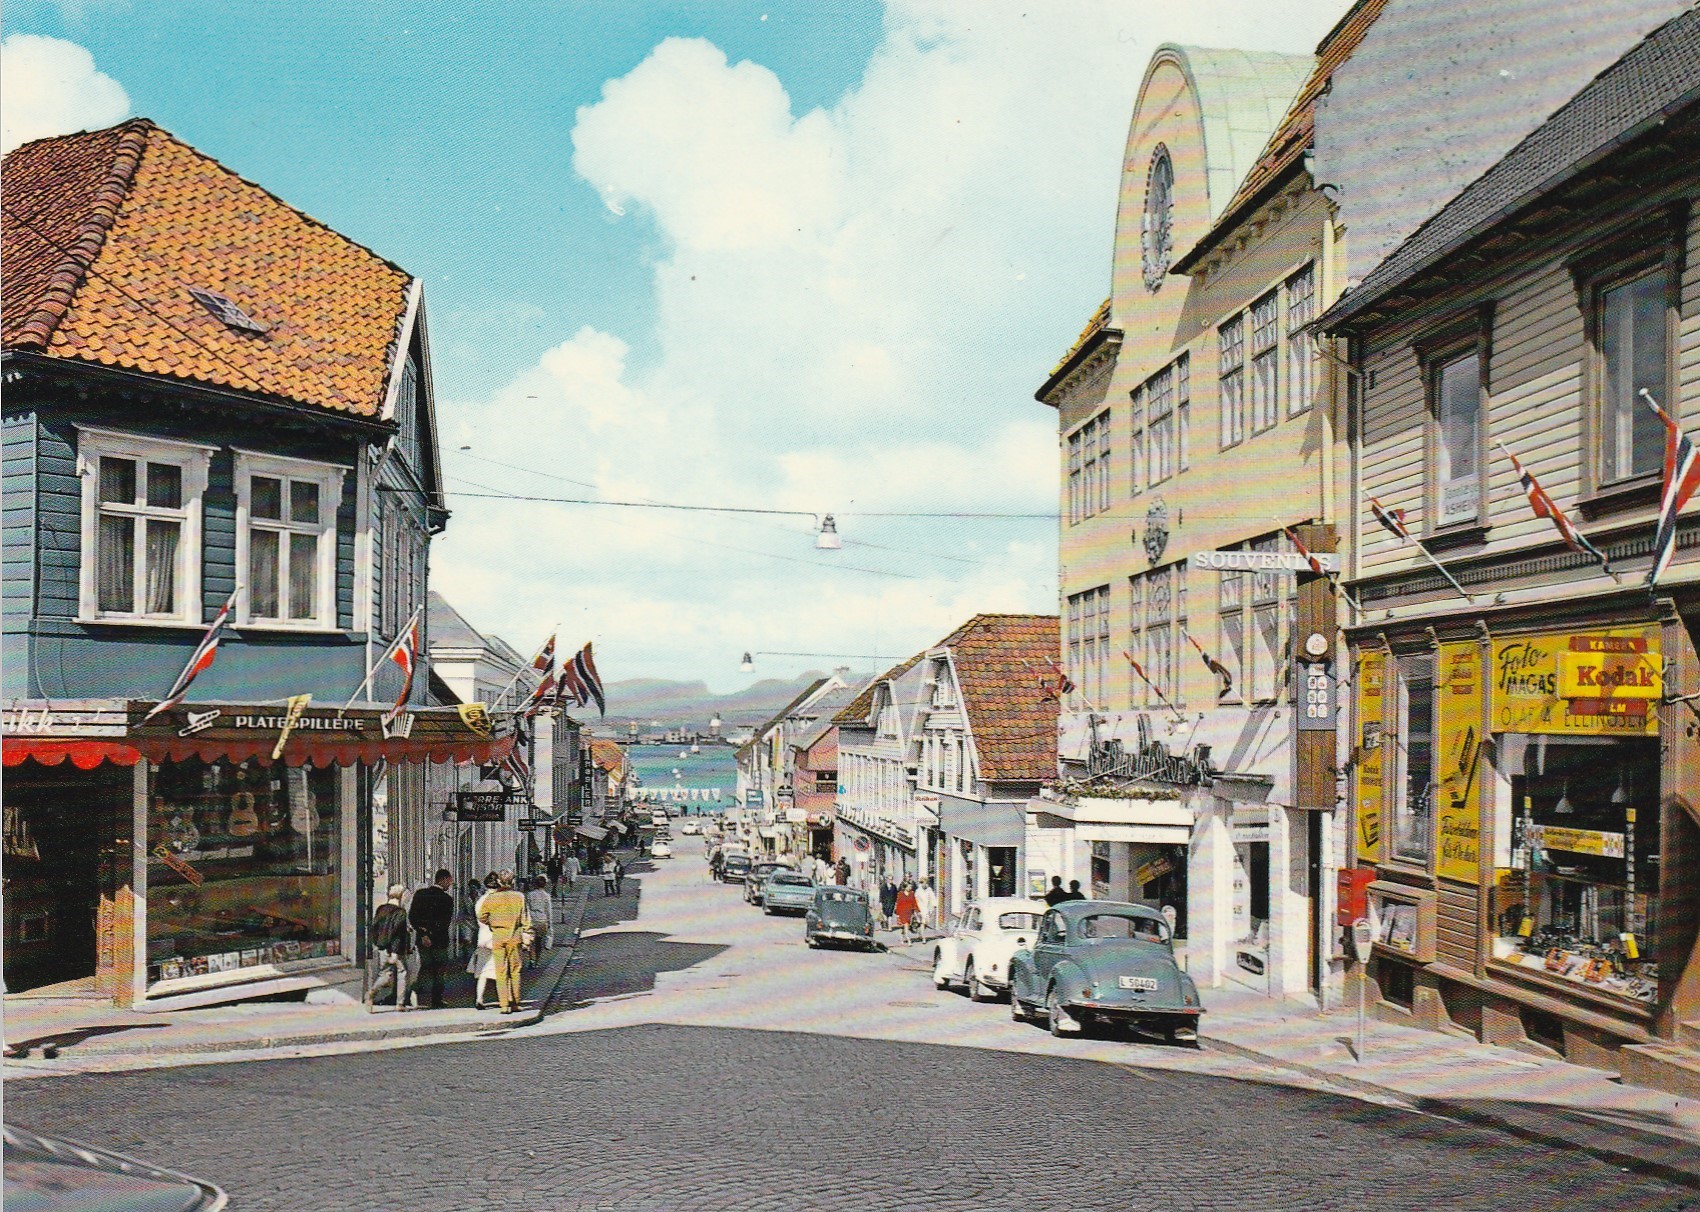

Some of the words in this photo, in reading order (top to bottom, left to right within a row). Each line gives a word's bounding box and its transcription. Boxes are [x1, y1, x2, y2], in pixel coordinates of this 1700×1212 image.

[1194, 551, 1332, 571] SOUVENIS
[1576, 665, 1655, 688] Kodak
[2, 707, 53, 733] ikk
